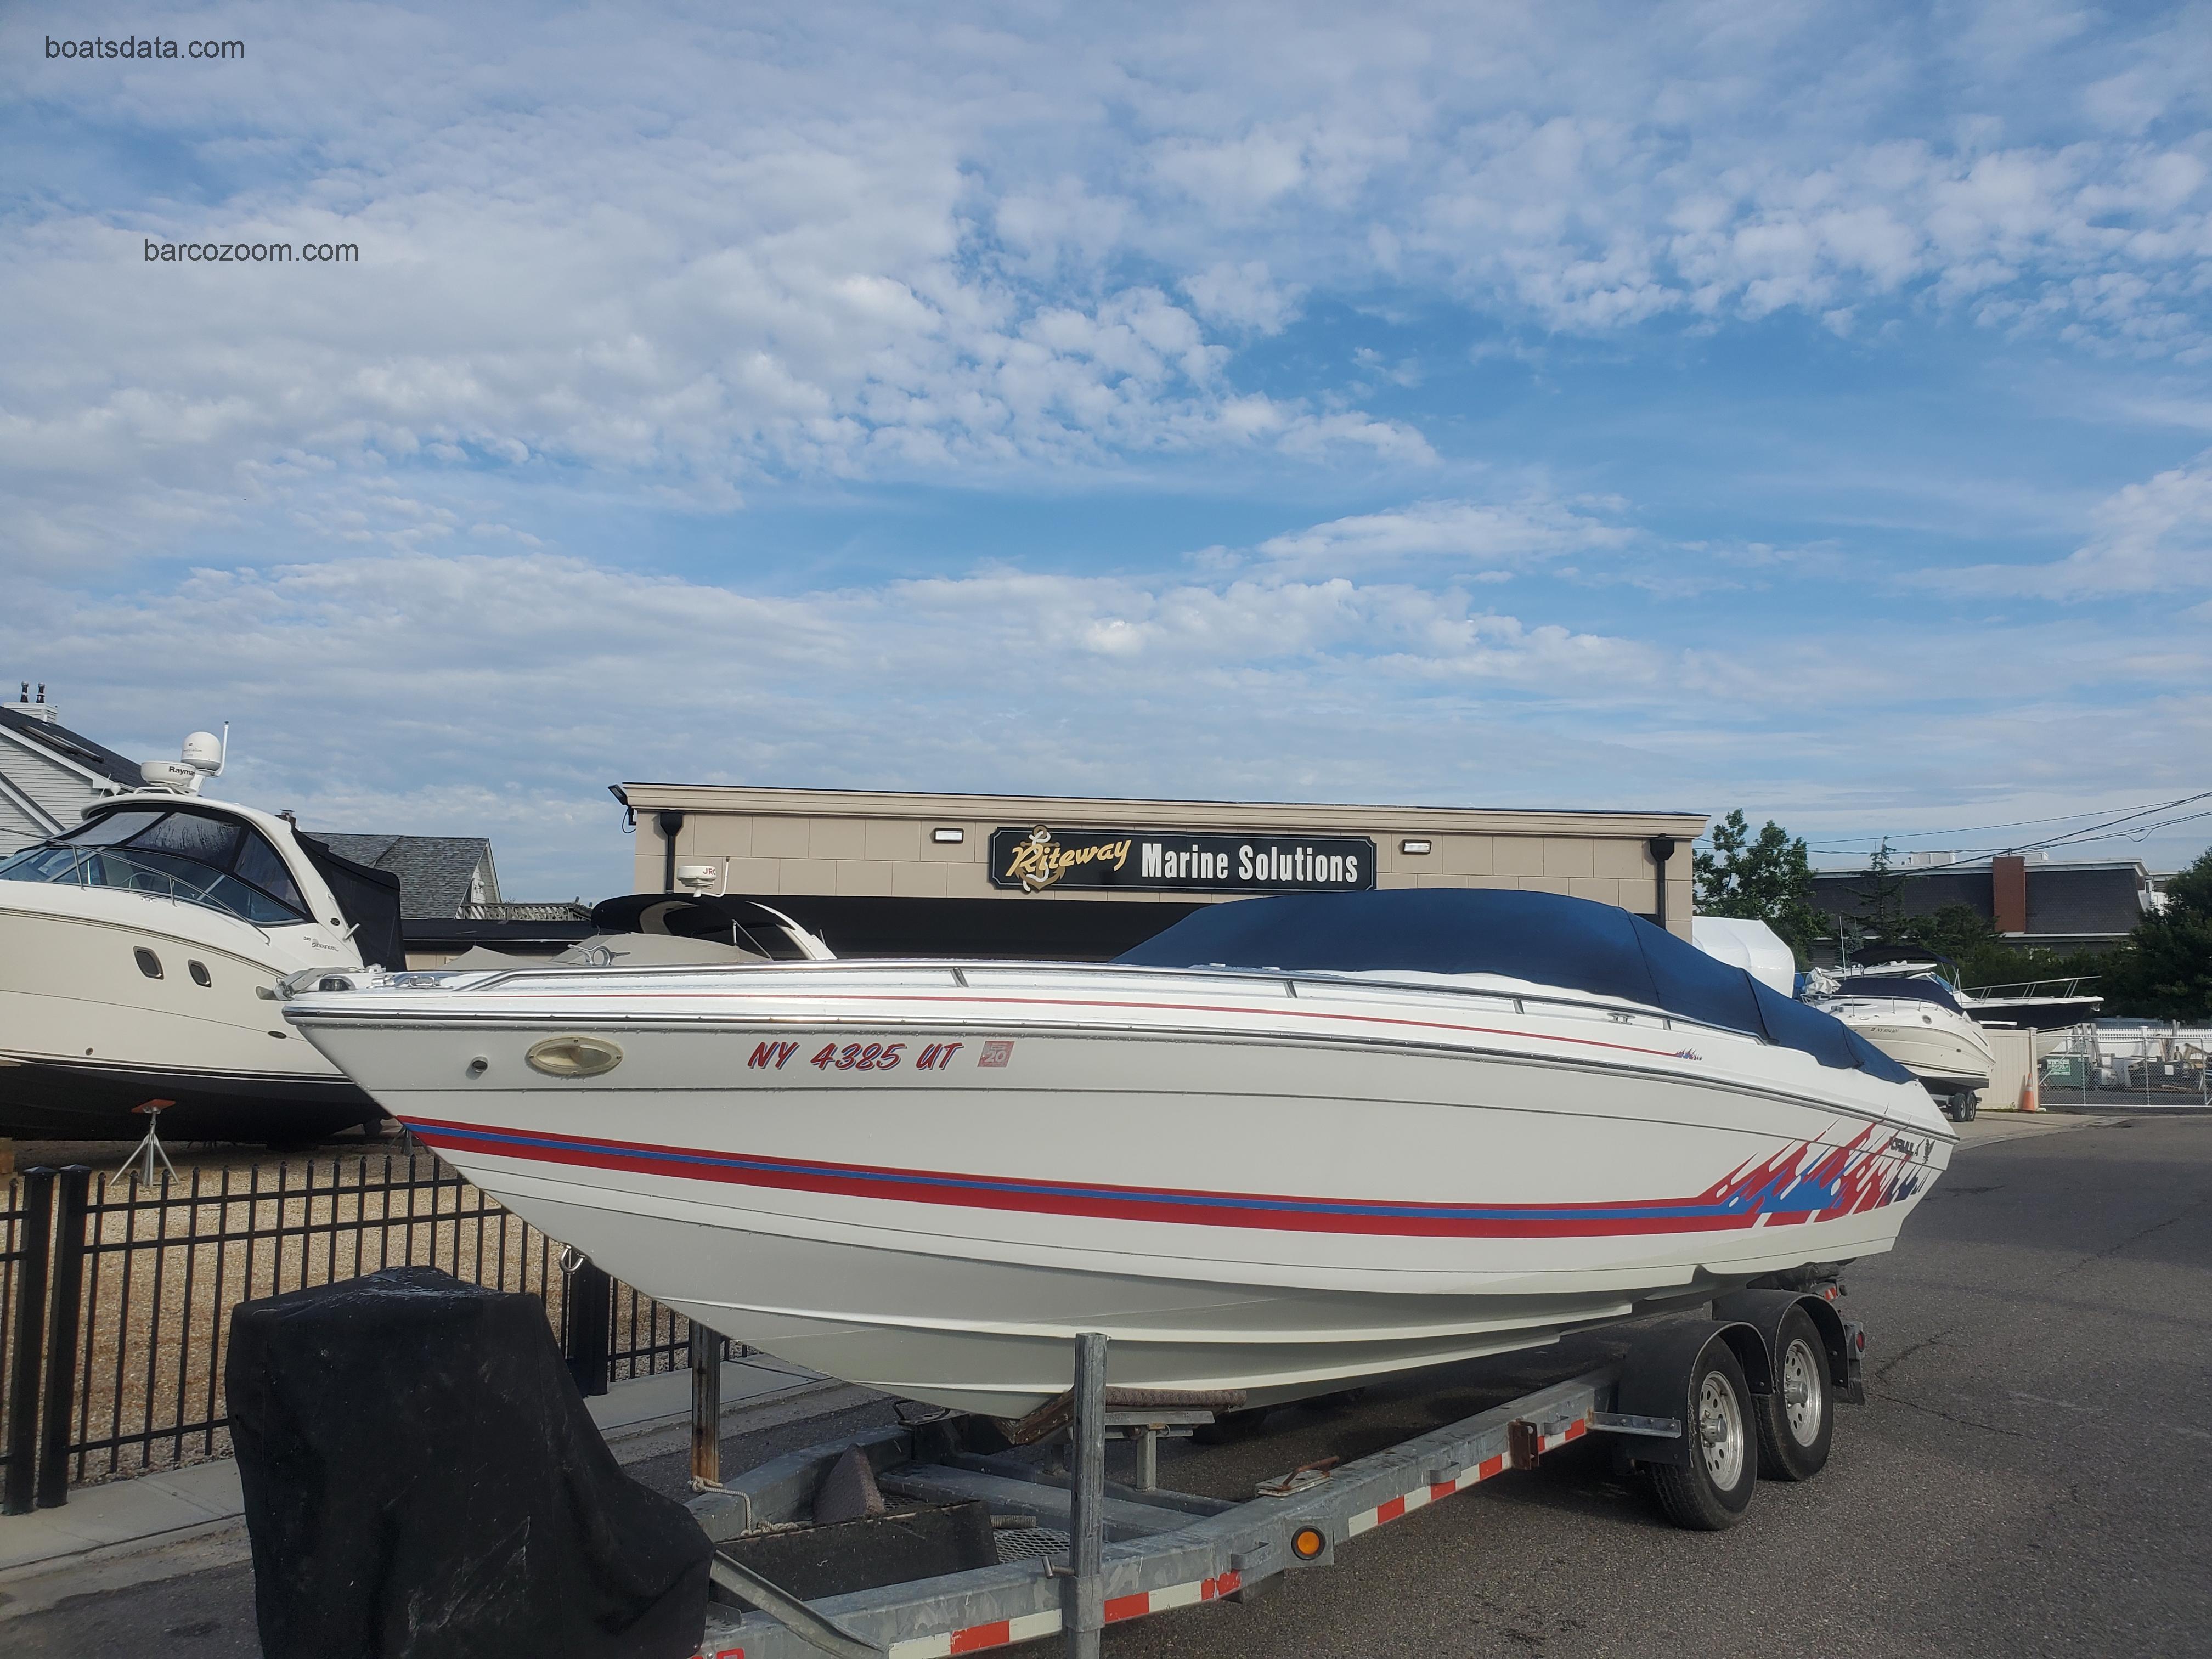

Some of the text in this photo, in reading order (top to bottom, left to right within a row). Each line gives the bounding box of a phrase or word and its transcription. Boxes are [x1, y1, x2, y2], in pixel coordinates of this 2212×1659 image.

[1005, 839, 1358, 882] Riteway Marine Solutions
[748, 1041, 964, 1071] NY 4385 UT
